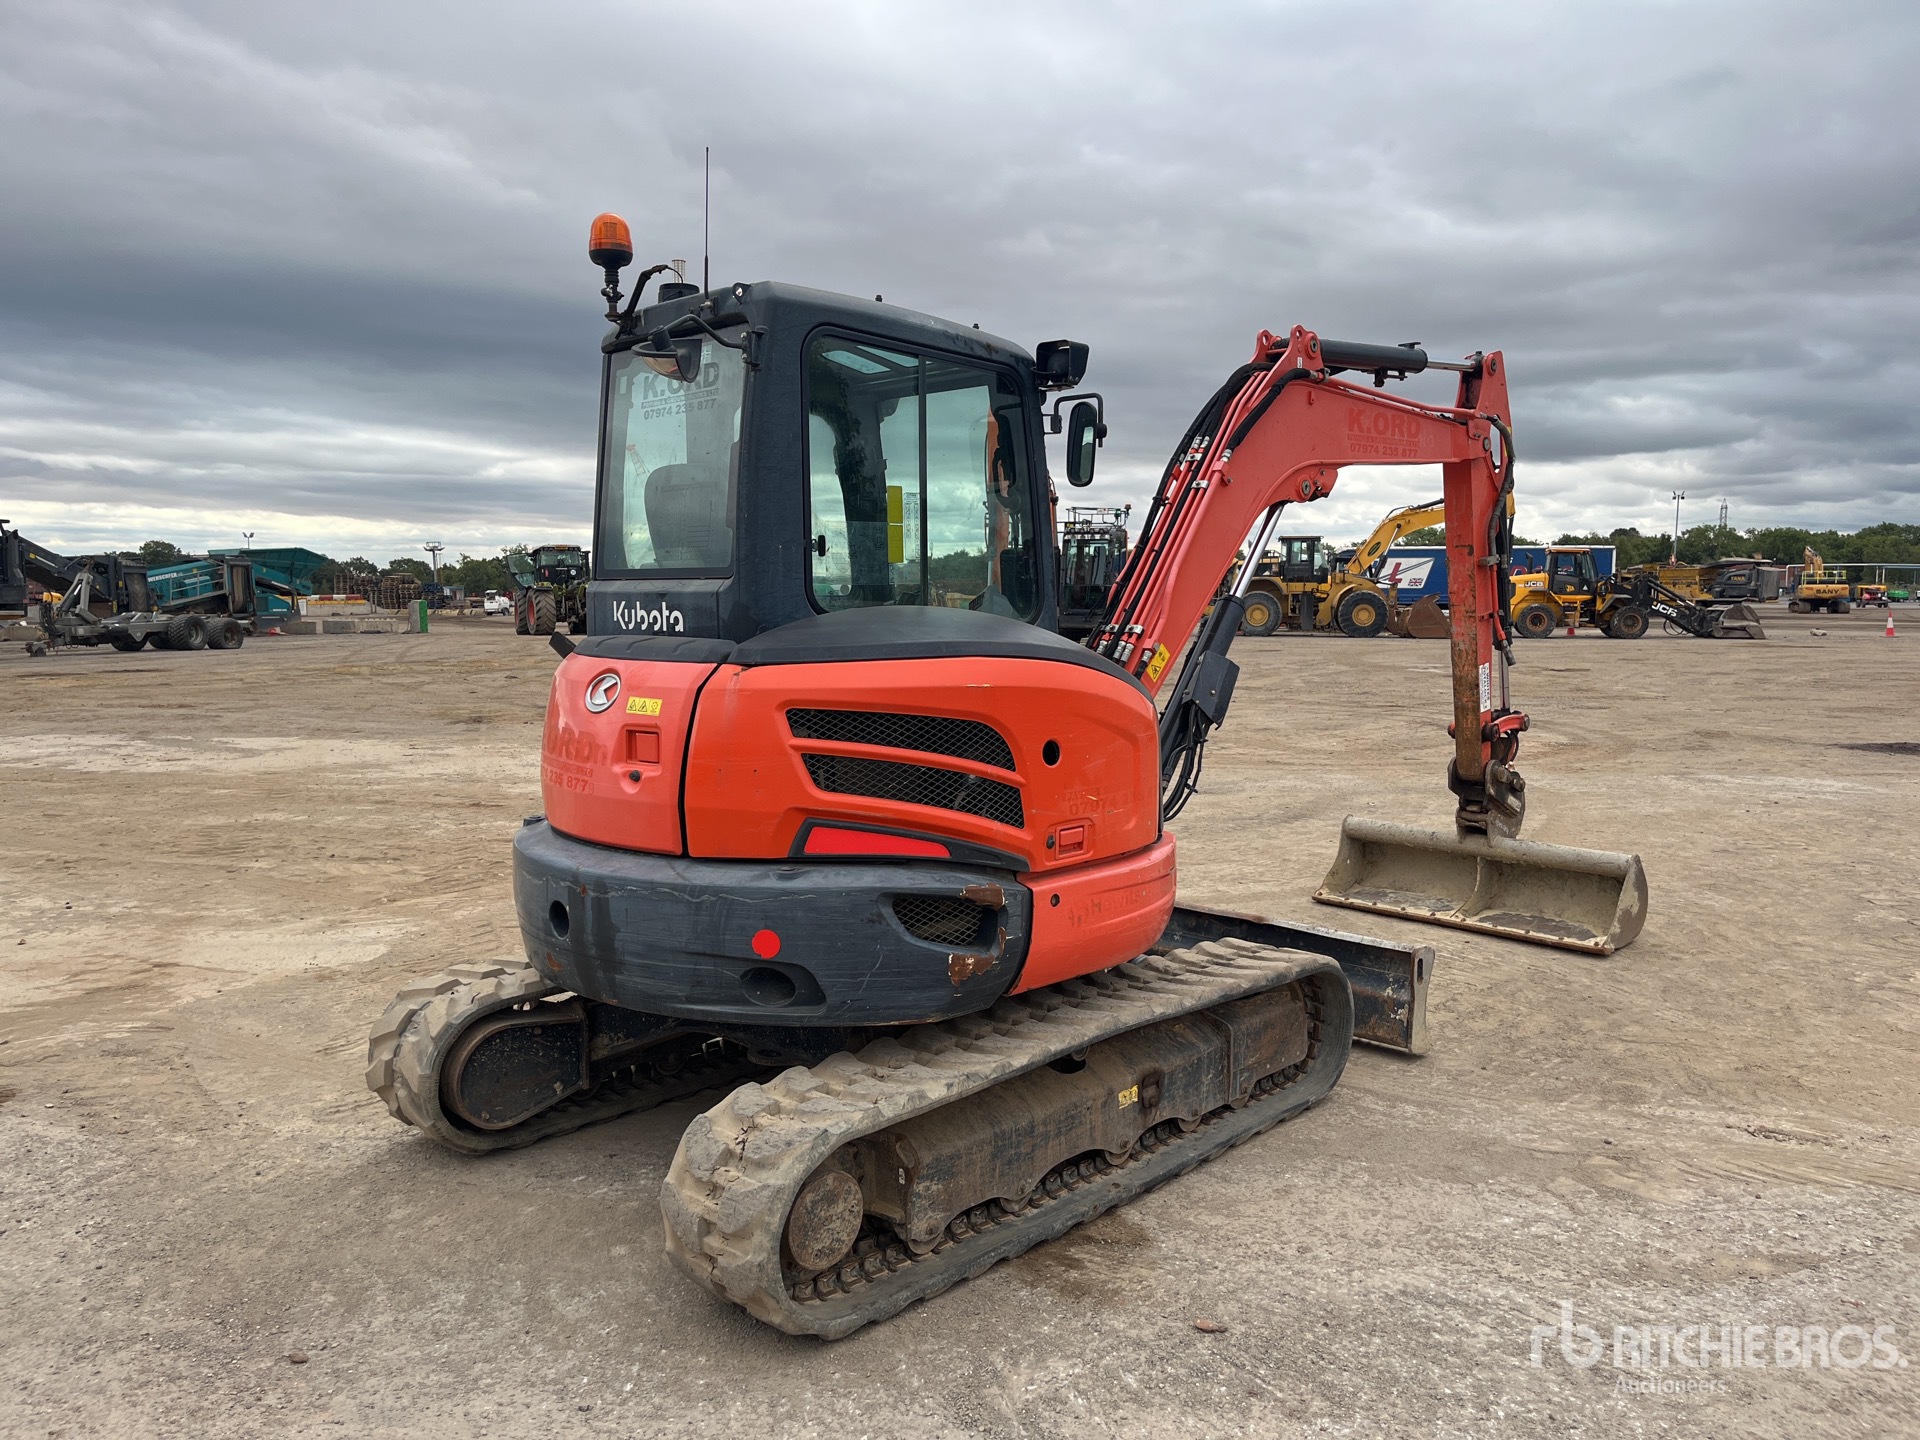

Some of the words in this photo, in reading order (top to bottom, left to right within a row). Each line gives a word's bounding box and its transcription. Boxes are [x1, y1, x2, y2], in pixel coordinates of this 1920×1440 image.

[643, 362, 719, 400] K.OD
[644, 406, 673, 420] 07974
[675, 401, 694, 415] 235
[697, 398, 717, 411] 877
[1348, 407, 1421, 439] K.ORD
[1350, 443, 1380, 455] 07974
[1382, 446, 1399, 456] 235
[1402, 448, 1418, 458] 877
[613, 601, 684, 632] Kubota
[1651, 602, 1678, 618] JCB
